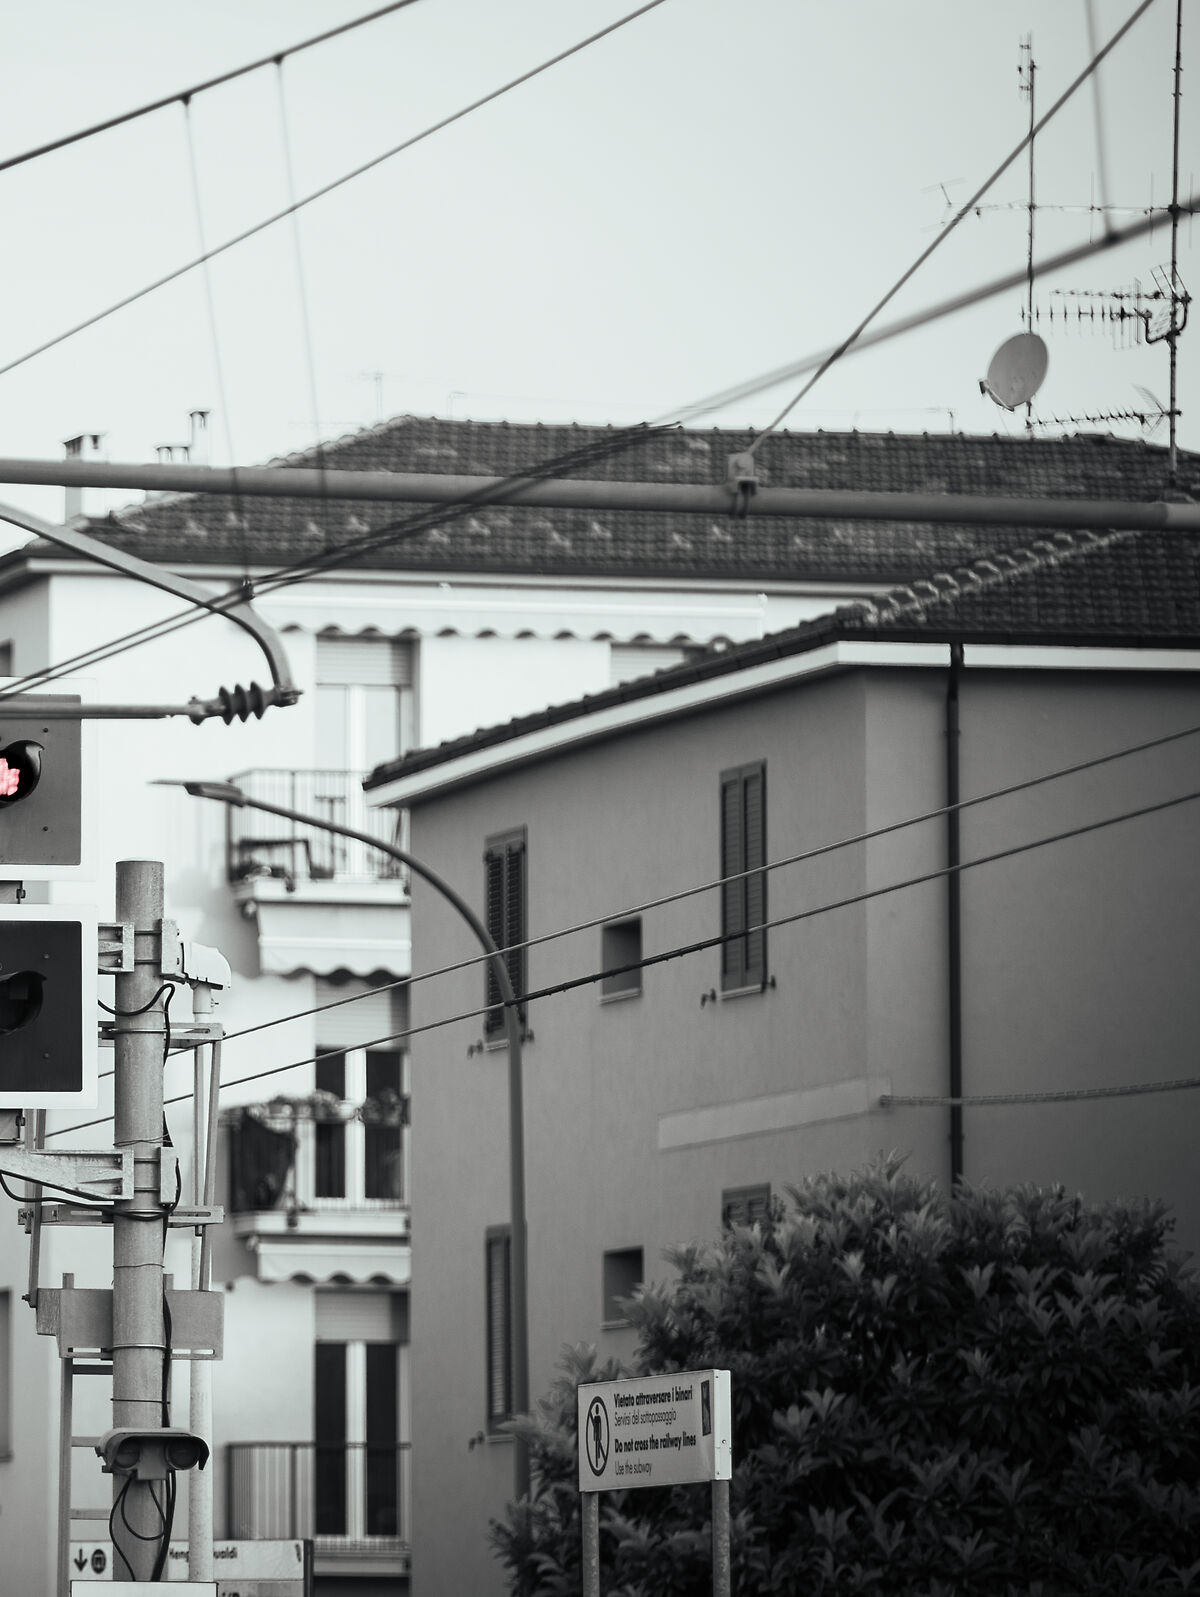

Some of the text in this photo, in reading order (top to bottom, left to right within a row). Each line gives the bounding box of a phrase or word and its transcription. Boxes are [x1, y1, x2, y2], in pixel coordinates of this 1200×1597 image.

[614, 1393, 634, 1408] Vietato
[636, 1392, 671, 1406] attraversare
[675, 1384, 693, 1402] binari
[640, 1408, 676, 1427] sottopassaggio
[614, 1430, 696, 1453] Do not cross the railway lines
[614, 1458, 653, 1476] Use the subway
